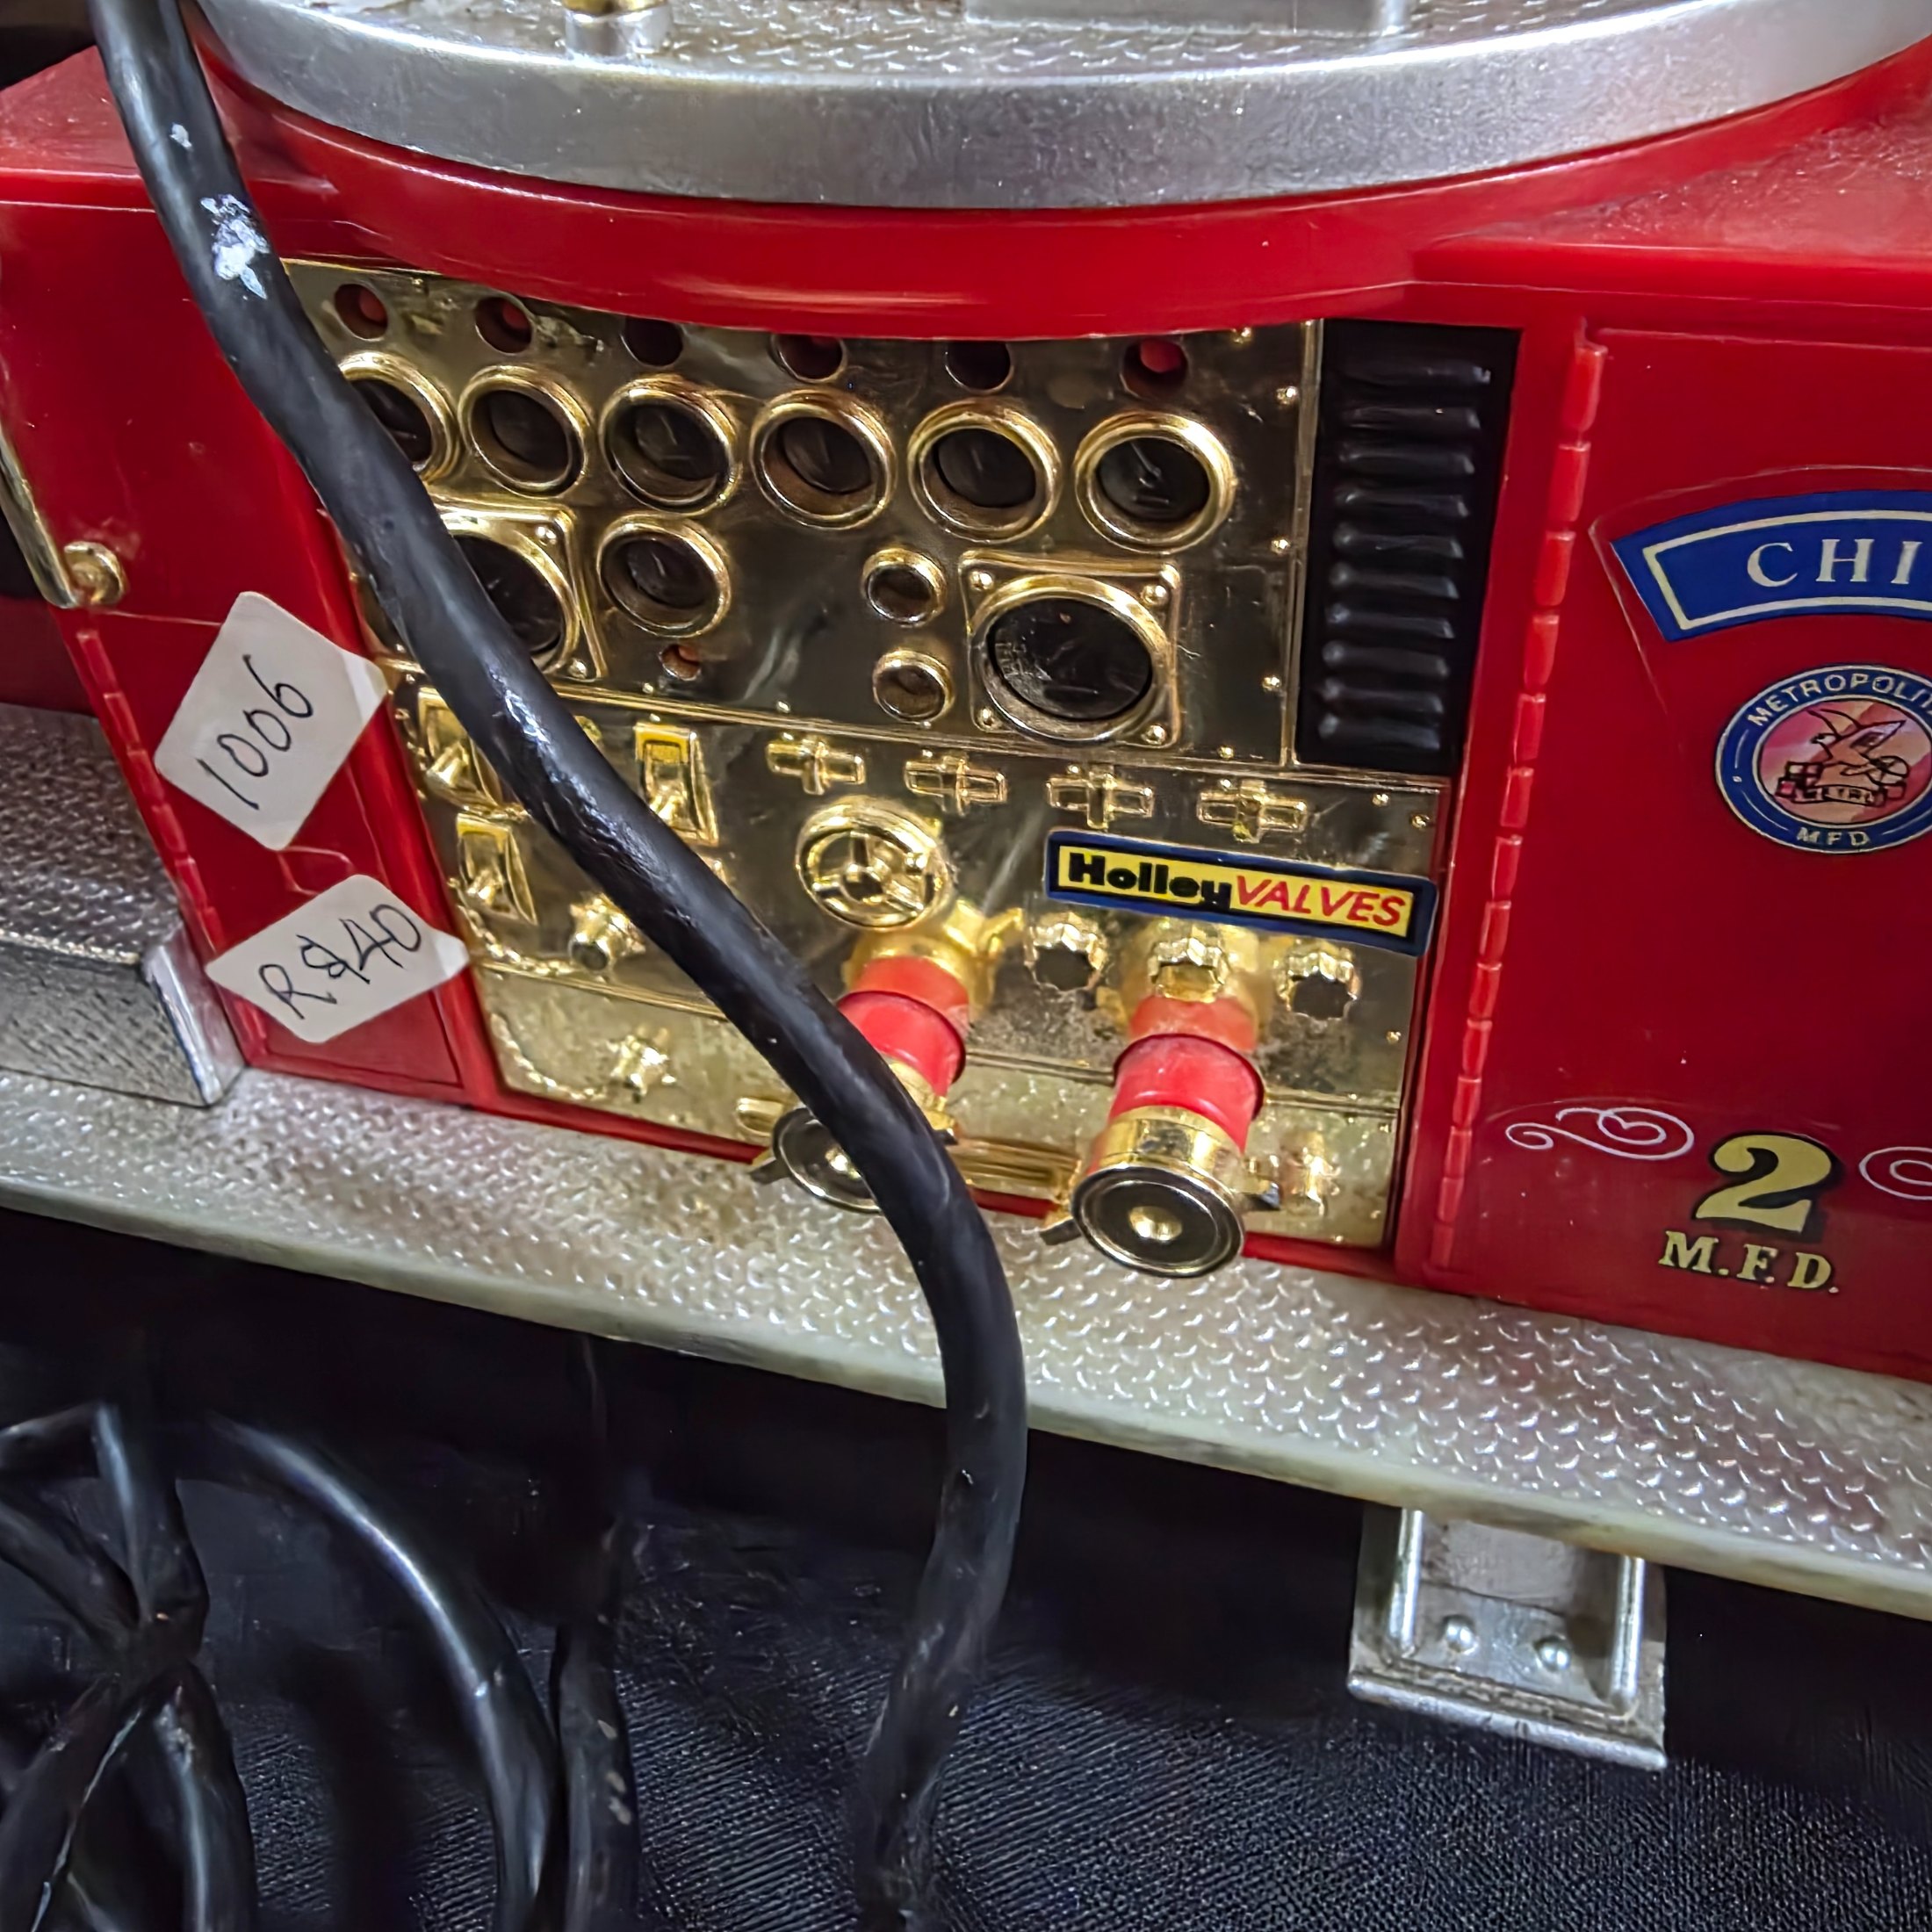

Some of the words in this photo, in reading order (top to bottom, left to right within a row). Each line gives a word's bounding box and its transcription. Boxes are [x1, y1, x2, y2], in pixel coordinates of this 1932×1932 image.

[1746, 537, 1923, 588] CHI
[1747, 672, 1932, 727] METROPOLIT
[195, 653, 314, 811] 1006
[1796, 826, 1871, 847] MFD
[1236, 875, 1406, 927] VALVES
[1694, 1132, 1835, 1236] 2
[1657, 1229, 1840, 1294] M.F.D.
